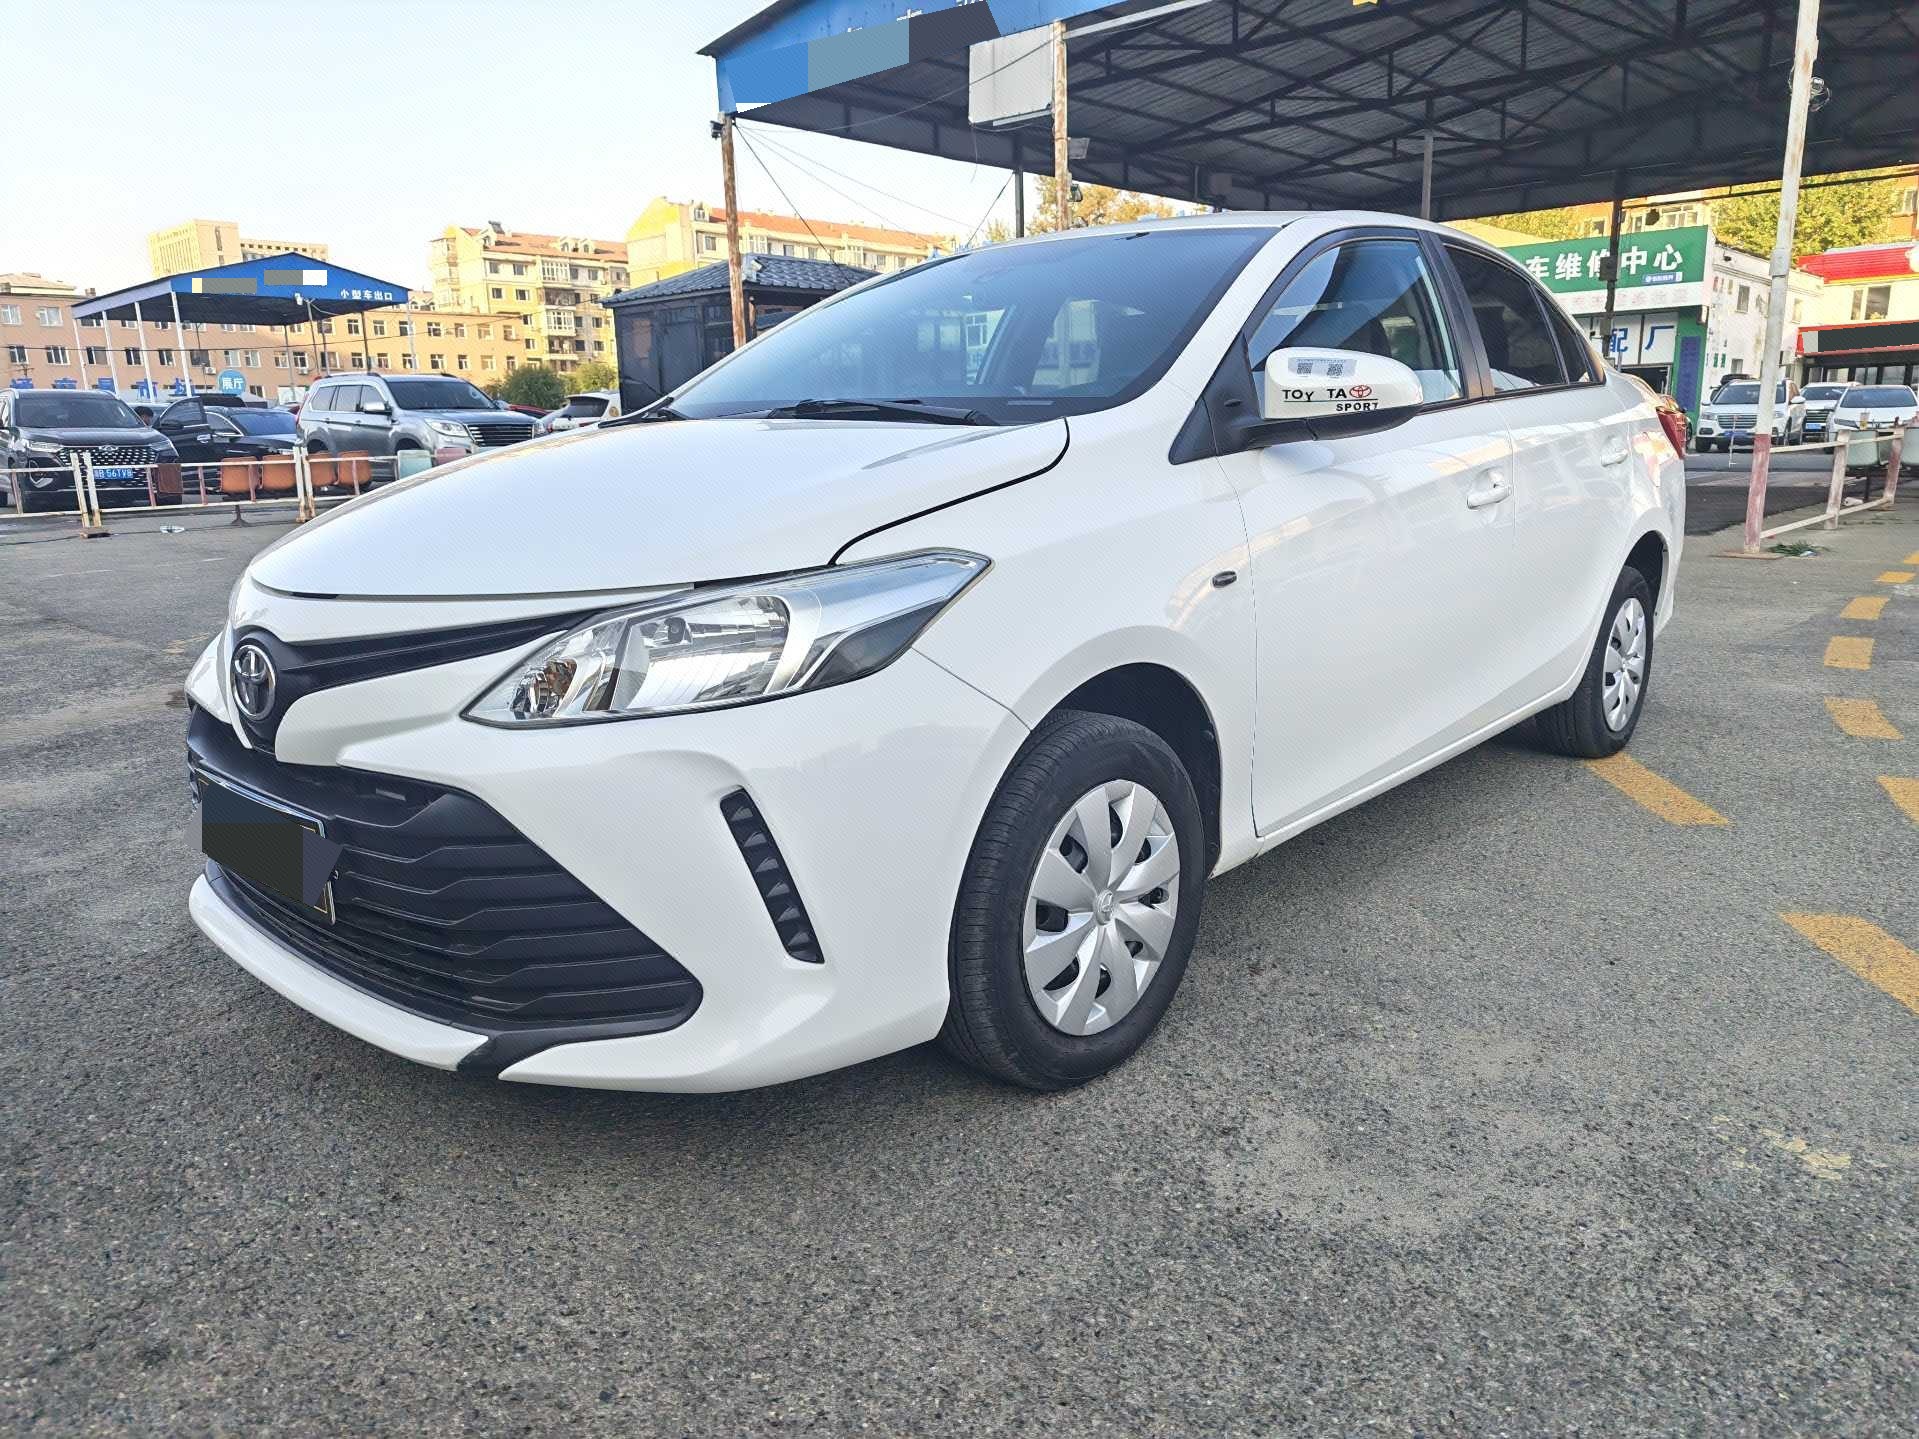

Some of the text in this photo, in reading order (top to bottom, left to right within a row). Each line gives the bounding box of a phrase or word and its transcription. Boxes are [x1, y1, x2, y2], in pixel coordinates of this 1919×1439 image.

[340, 288, 393, 301] 小型车出口
[221, 377, 244, 389] 展厅
[1335, 402, 1379, 412] SPORT
